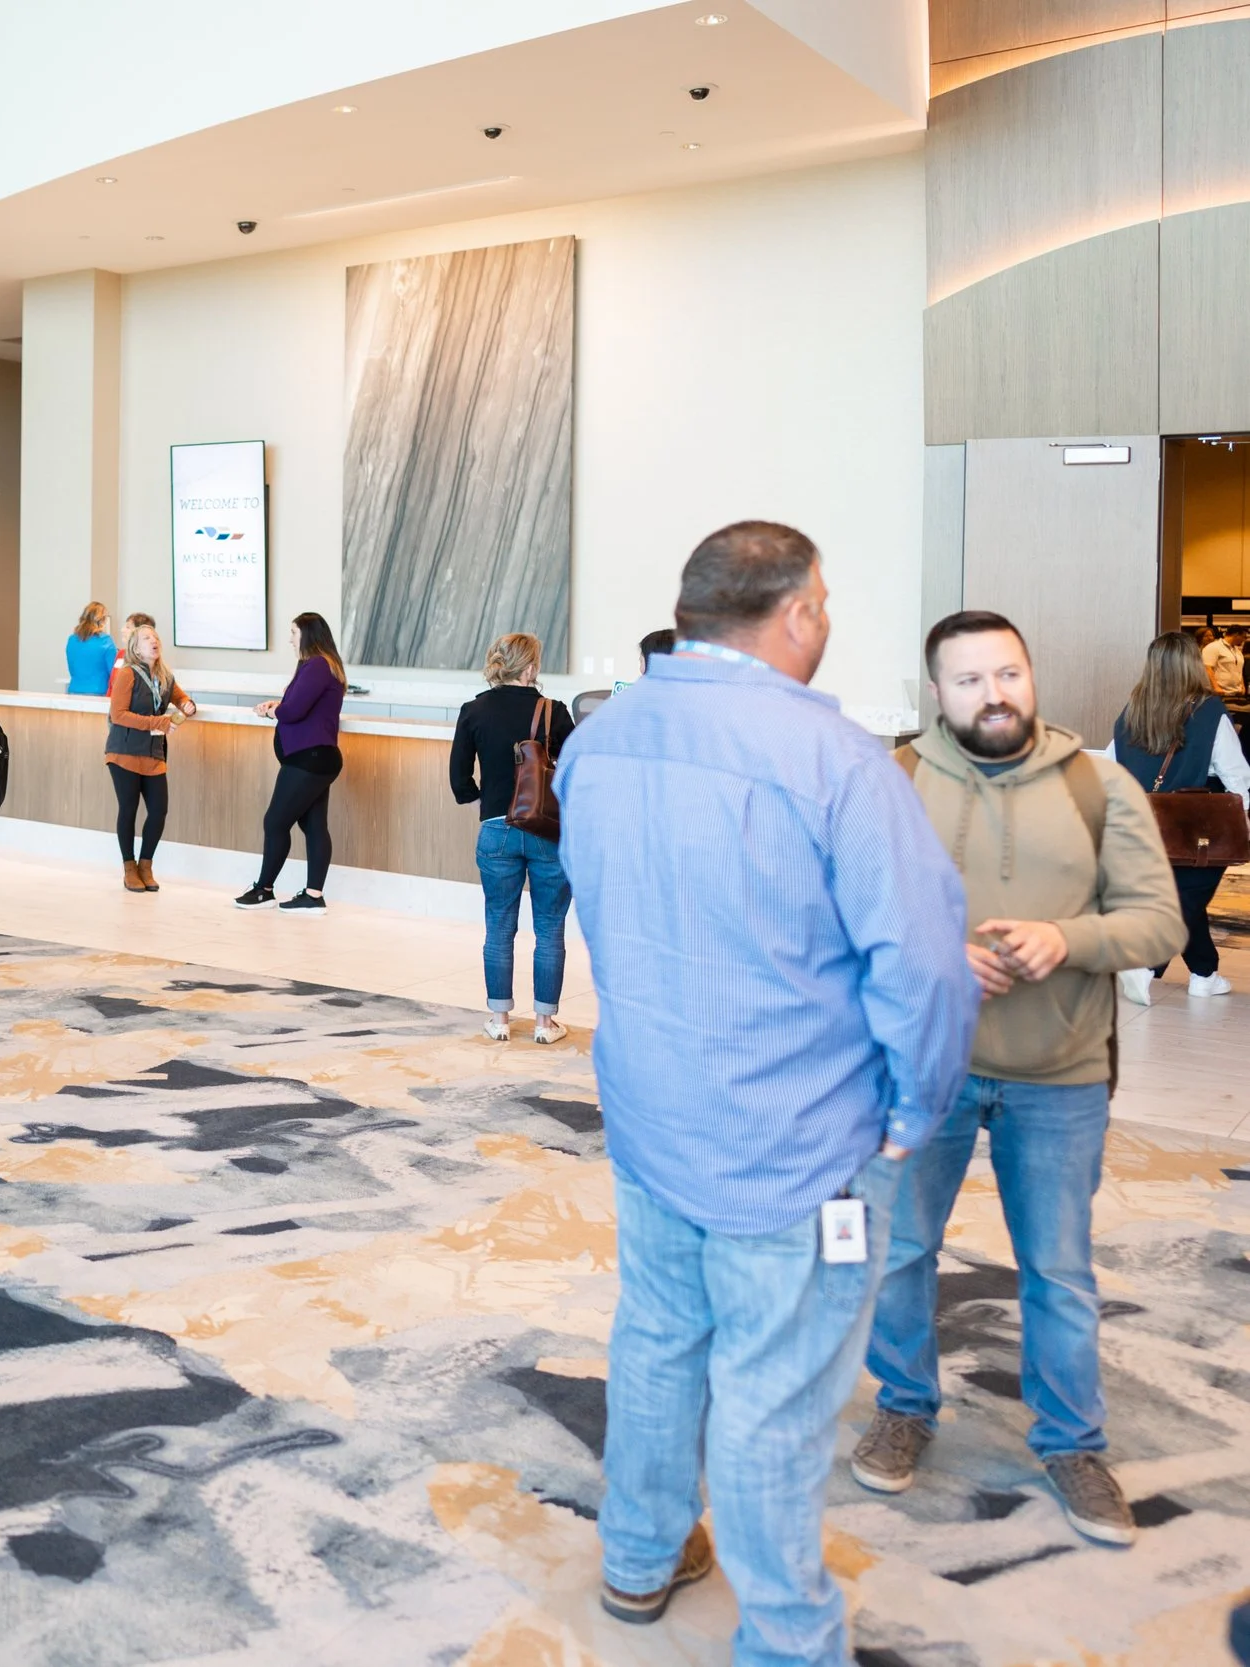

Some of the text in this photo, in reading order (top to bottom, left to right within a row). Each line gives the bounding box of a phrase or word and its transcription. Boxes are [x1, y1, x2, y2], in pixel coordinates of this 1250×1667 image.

[179, 496, 260, 510] WELCOME TO
[182, 552, 258, 564] MYSTIC LAKE
[200, 568, 238, 578] CENTER
